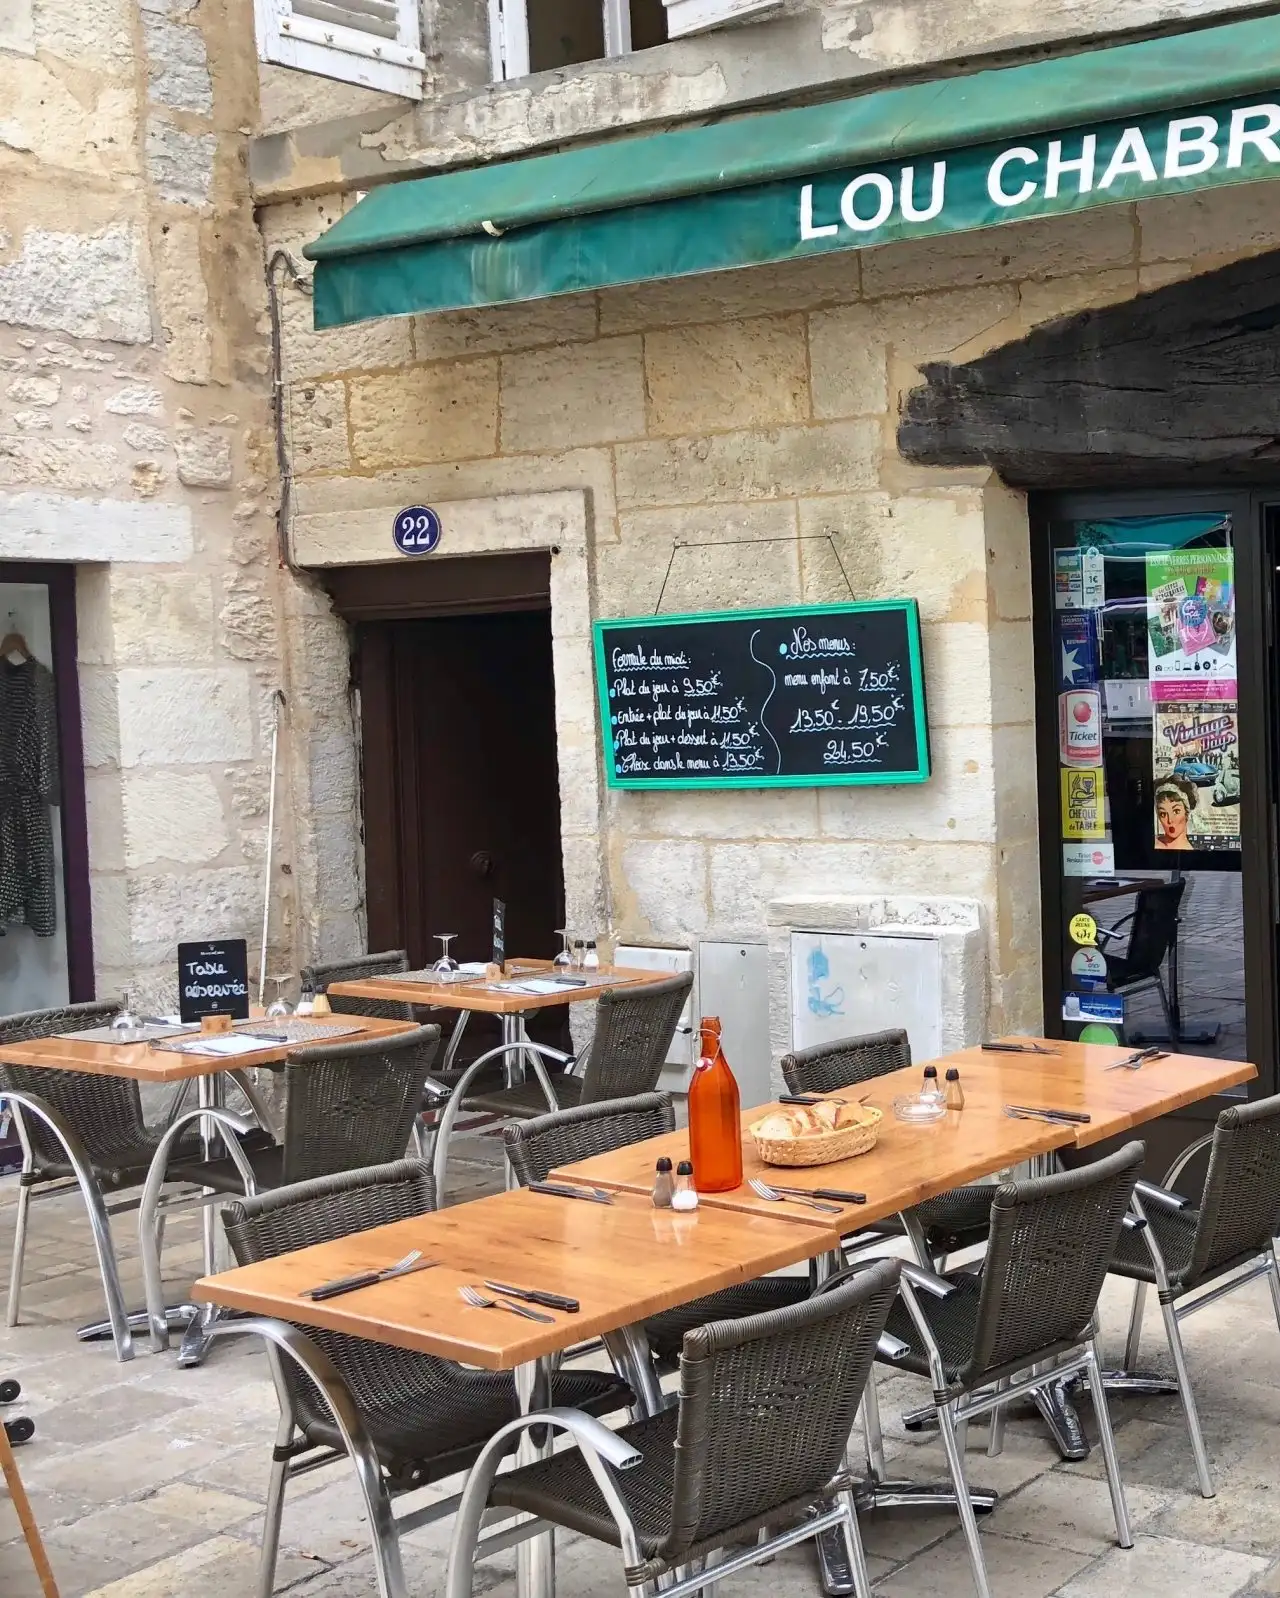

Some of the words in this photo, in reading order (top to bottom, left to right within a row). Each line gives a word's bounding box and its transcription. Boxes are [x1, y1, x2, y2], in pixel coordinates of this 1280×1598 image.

[799, 162, 946, 240] LOU
[402, 515, 430, 546] 22
[791, 626, 816, 655] Nos
[613, 645, 647, 668] Formule
[650, 649, 663, 666] du
[614, 677, 636, 697] Plat
[638, 680, 650, 695] du
[671, 680, 679, 693] à
[784, 674, 808, 686] menu
[811, 667, 840, 694] enfant
[843, 668, 851, 685] à
[617, 706, 645, 724] Entrée
[646, 712, 652, 721] +
[653, 703, 672, 726] plat
[675, 705, 686, 720] du
[703, 706, 711, 720] à
[616, 729, 638, 747] Plat
[639, 732, 651, 745] du
[670, 735, 676, 743] +
[677, 729, 708, 746] dessert
[710, 732, 718, 746] à
[1069, 732, 1097, 741] Ticket
[1163, 714, 1234, 747] Vintage
[1202, 732, 1237, 752] Days
[621, 752, 651, 773] Choix
[687, 759, 710, 770] menu
[713, 755, 719, 768] à
[1075, 821, 1097, 830] TABLE
[185, 961, 228, 975] Table
[185, 979, 248, 998] réservée
